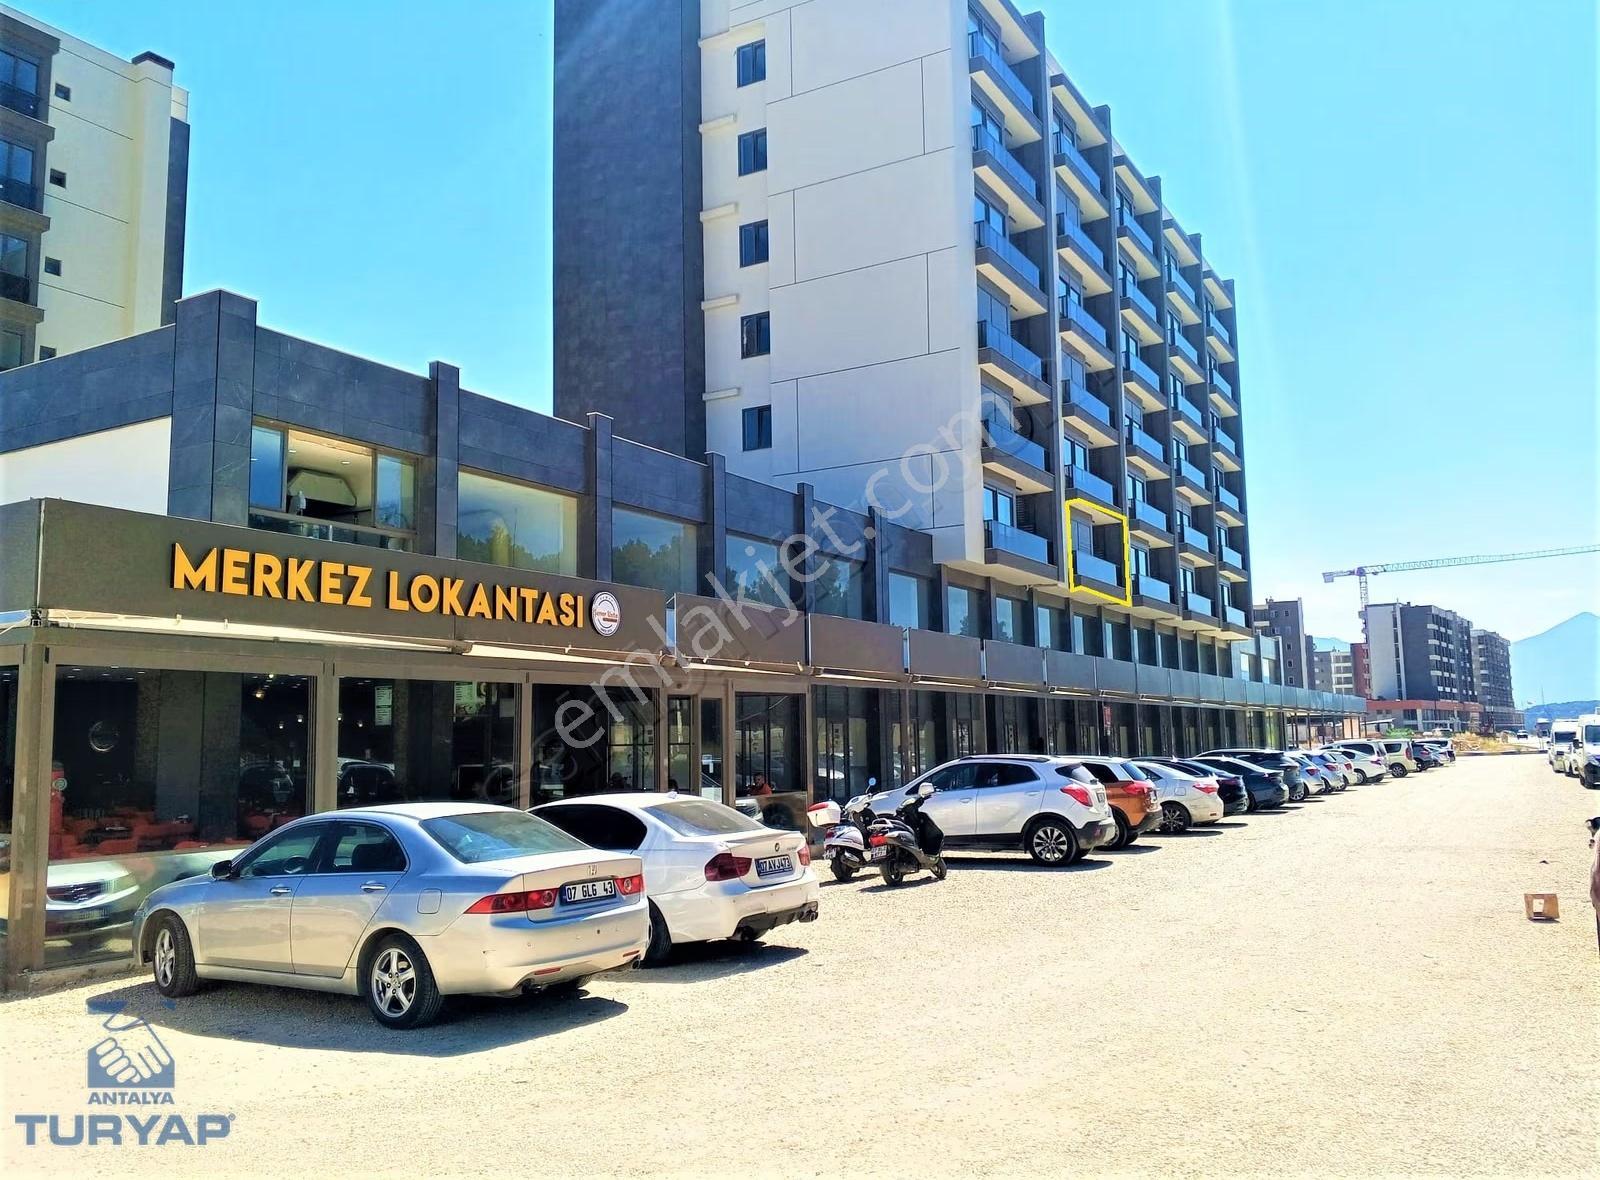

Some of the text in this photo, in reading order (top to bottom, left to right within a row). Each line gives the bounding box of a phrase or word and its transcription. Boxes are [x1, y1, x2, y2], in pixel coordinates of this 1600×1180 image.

[172, 542, 585, 628] MERKEZ LOKANTASI
[566, 881, 613, 900] 07 GLG 43
